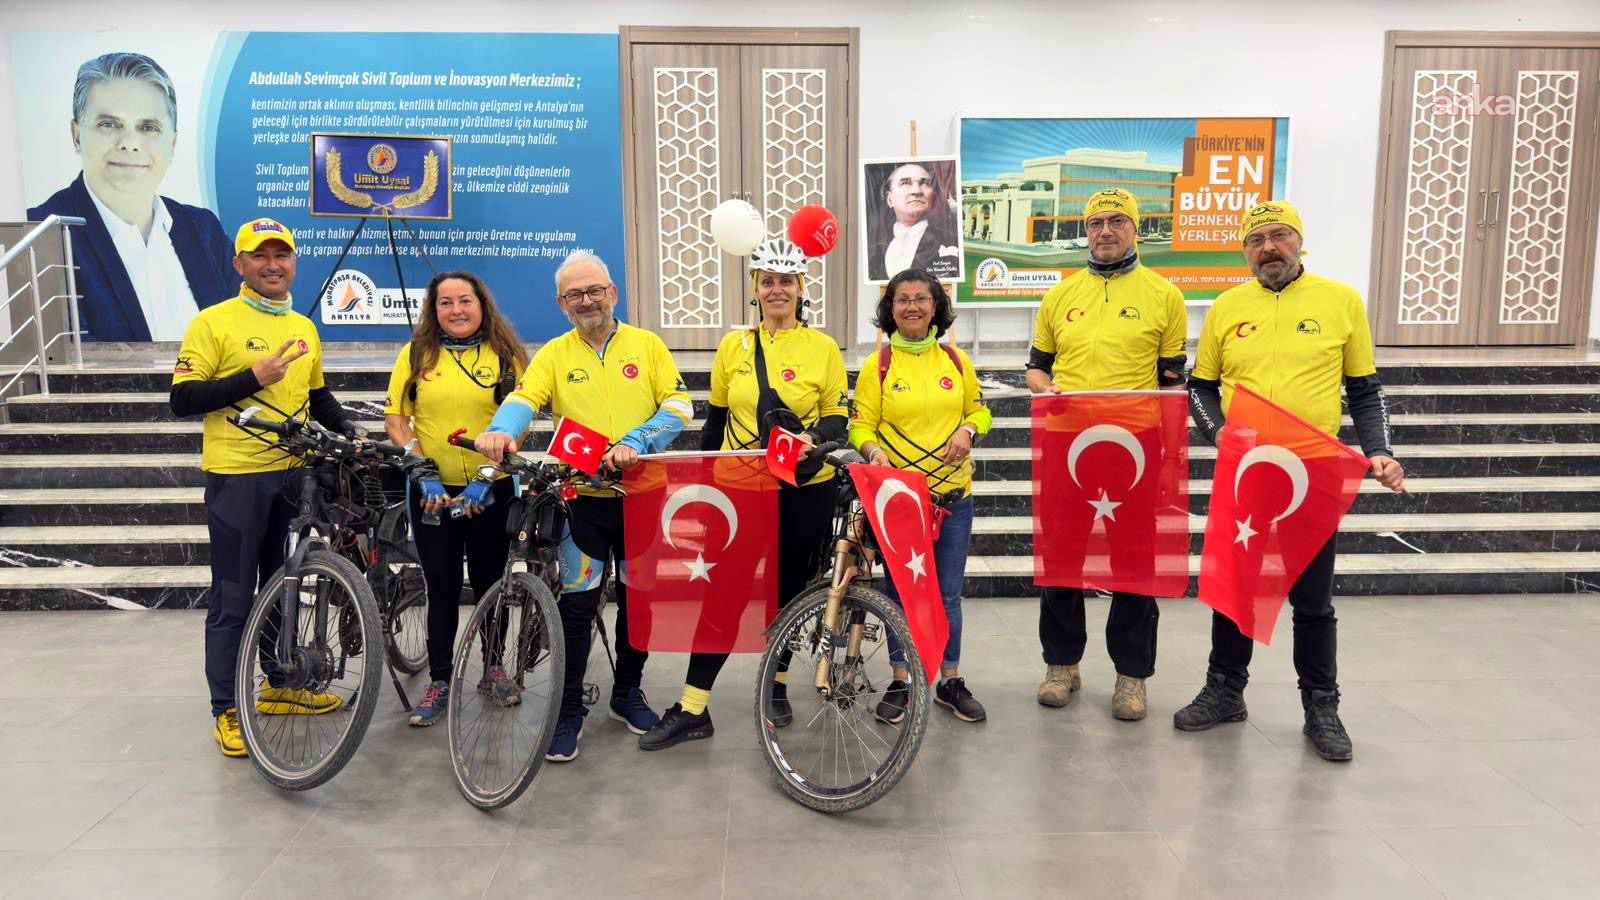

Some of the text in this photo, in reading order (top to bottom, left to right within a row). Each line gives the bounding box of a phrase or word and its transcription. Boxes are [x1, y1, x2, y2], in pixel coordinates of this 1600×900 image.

[249, 71, 301, 85] Abdullah
[304, 71, 359, 88] Sevimçok
[362, 72, 387, 86] Sivil
[389, 72, 431, 88] Toplum
[434, 74, 447, 86] ve
[449, 69, 507, 88] İnovasyon
[509, 73, 574, 87] Merkezimiz
[251, 99, 584, 114] kentimizin ortak aklının oluşması, kentlilik bilincinin gelişmesi ve Antalya'nın
[252, 115, 588, 131] geleceği için birlikte sürdürülebilir çalışmaların yürütülmesi için kurulmuş bir
[253, 131, 289, 145] yerleşke
[291, 132, 310, 143] olar
[471, 133, 525, 146] somutlaşmış
[528, 134, 558, 145] halidir.
[1196, 134, 1265, 152] TÜRKİYE'NİN
[256, 163, 275, 175] Sivil
[277, 163, 309, 177] Toplum
[467, 164, 512, 179] geleceğini
[514, 165, 571, 179] düşünenlerin
[1209, 155, 1264, 185] EN
[256, 180, 294, 193] organize
[295, 180, 310, 191] old
[467, 181, 505, 193] ülkemize
[507, 181, 529, 193] ciddi
[530, 182, 570, 195] zenginlik
[258, 196, 306, 208] katacakları
[1180, 187, 1260, 211] BÜYÜK
[1179, 214, 1242, 226] DERNEKL
[291, 228, 314, 239] Kenti
[316, 231, 326, 239] ve
[328, 228, 359, 240] halkın
[419, 228, 445, 240] bunun
[447, 228, 464, 242] için
[466, 229, 488, 242] proje
[490, 229, 521, 241] üretme
[523, 232, 533, 241] ve
[535, 230, 576, 243] uygulama
[430, 245, 448, 256] olan
[451, 245, 499, 256] merkezimiz
[501, 245, 540, 258] hepimize
[541, 246, 569, 259] hayırlı
[1011, 273, 1030, 281] Ümit
[382, 294, 419, 309] Ümit
